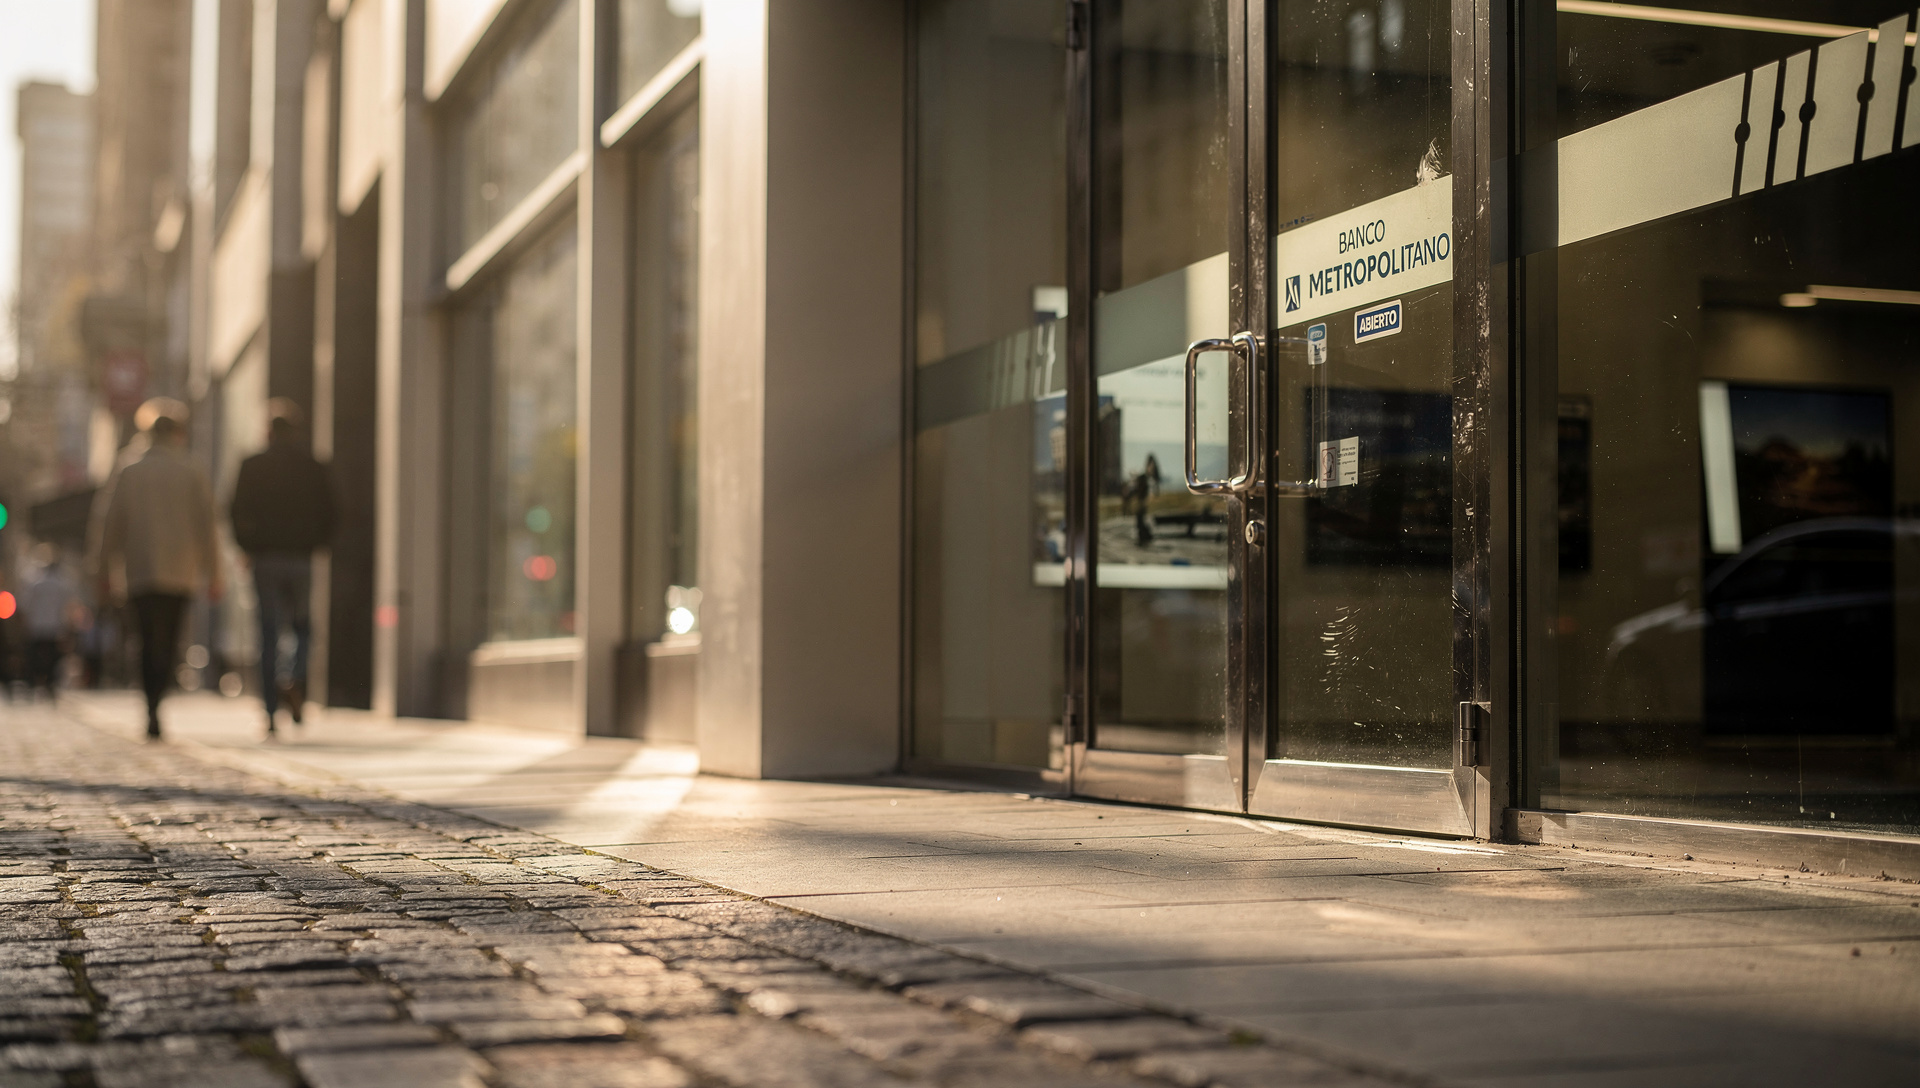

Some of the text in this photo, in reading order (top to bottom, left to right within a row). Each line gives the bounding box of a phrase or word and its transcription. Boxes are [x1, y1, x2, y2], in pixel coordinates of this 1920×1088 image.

[1338, 219, 1386, 254] BANCO
[1309, 232, 1451, 299] METROPOLITANO
[1358, 309, 1397, 334] ABIERTO
